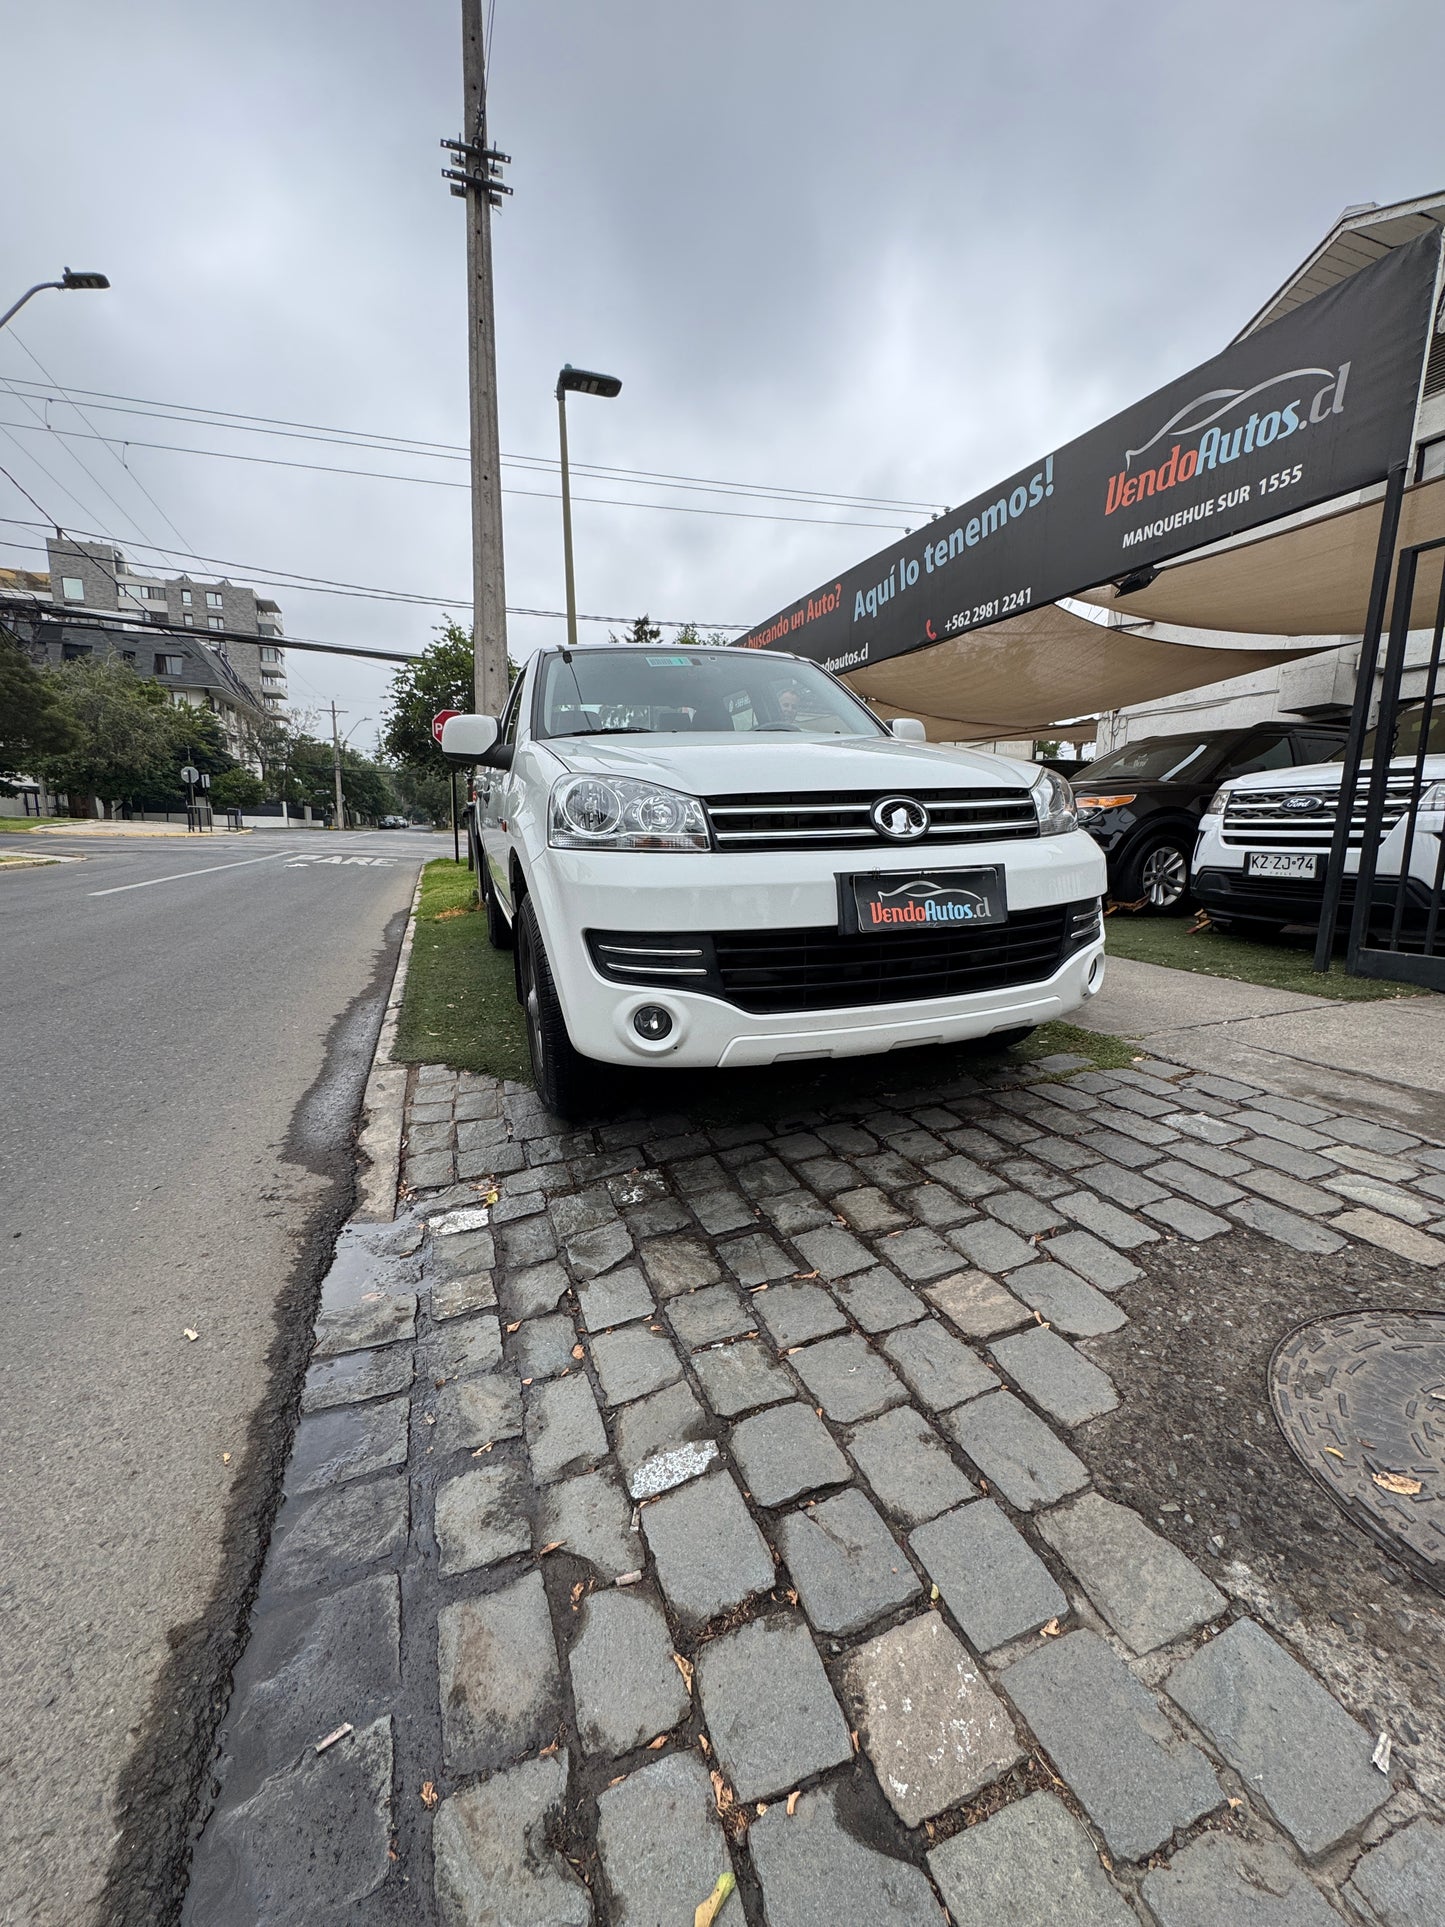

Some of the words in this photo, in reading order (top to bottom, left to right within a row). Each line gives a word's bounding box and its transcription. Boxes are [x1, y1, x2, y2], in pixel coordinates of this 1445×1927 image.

[1104, 361, 1351, 516] VendoAutos.cl
[1122, 499, 1214, 549] MANQUEHUE
[1217, 485, 1250, 512] SUR
[1259, 464, 1303, 496] 1555
[853, 564, 895, 623] Aquí
[900, 557, 920, 592] lo
[924, 454, 1054, 575] tenemos!
[791, 609, 804, 630] un
[806, 583, 842, 623] Auto?
[944, 610, 970, 632] +562
[972, 599, 999, 623] 2981
[1001, 587, 1031, 613] 2241
[1286, 798, 1311, 808] Ford
[282, 854, 398, 867] PARE
[870, 897, 991, 924] VendoAutos.cl
